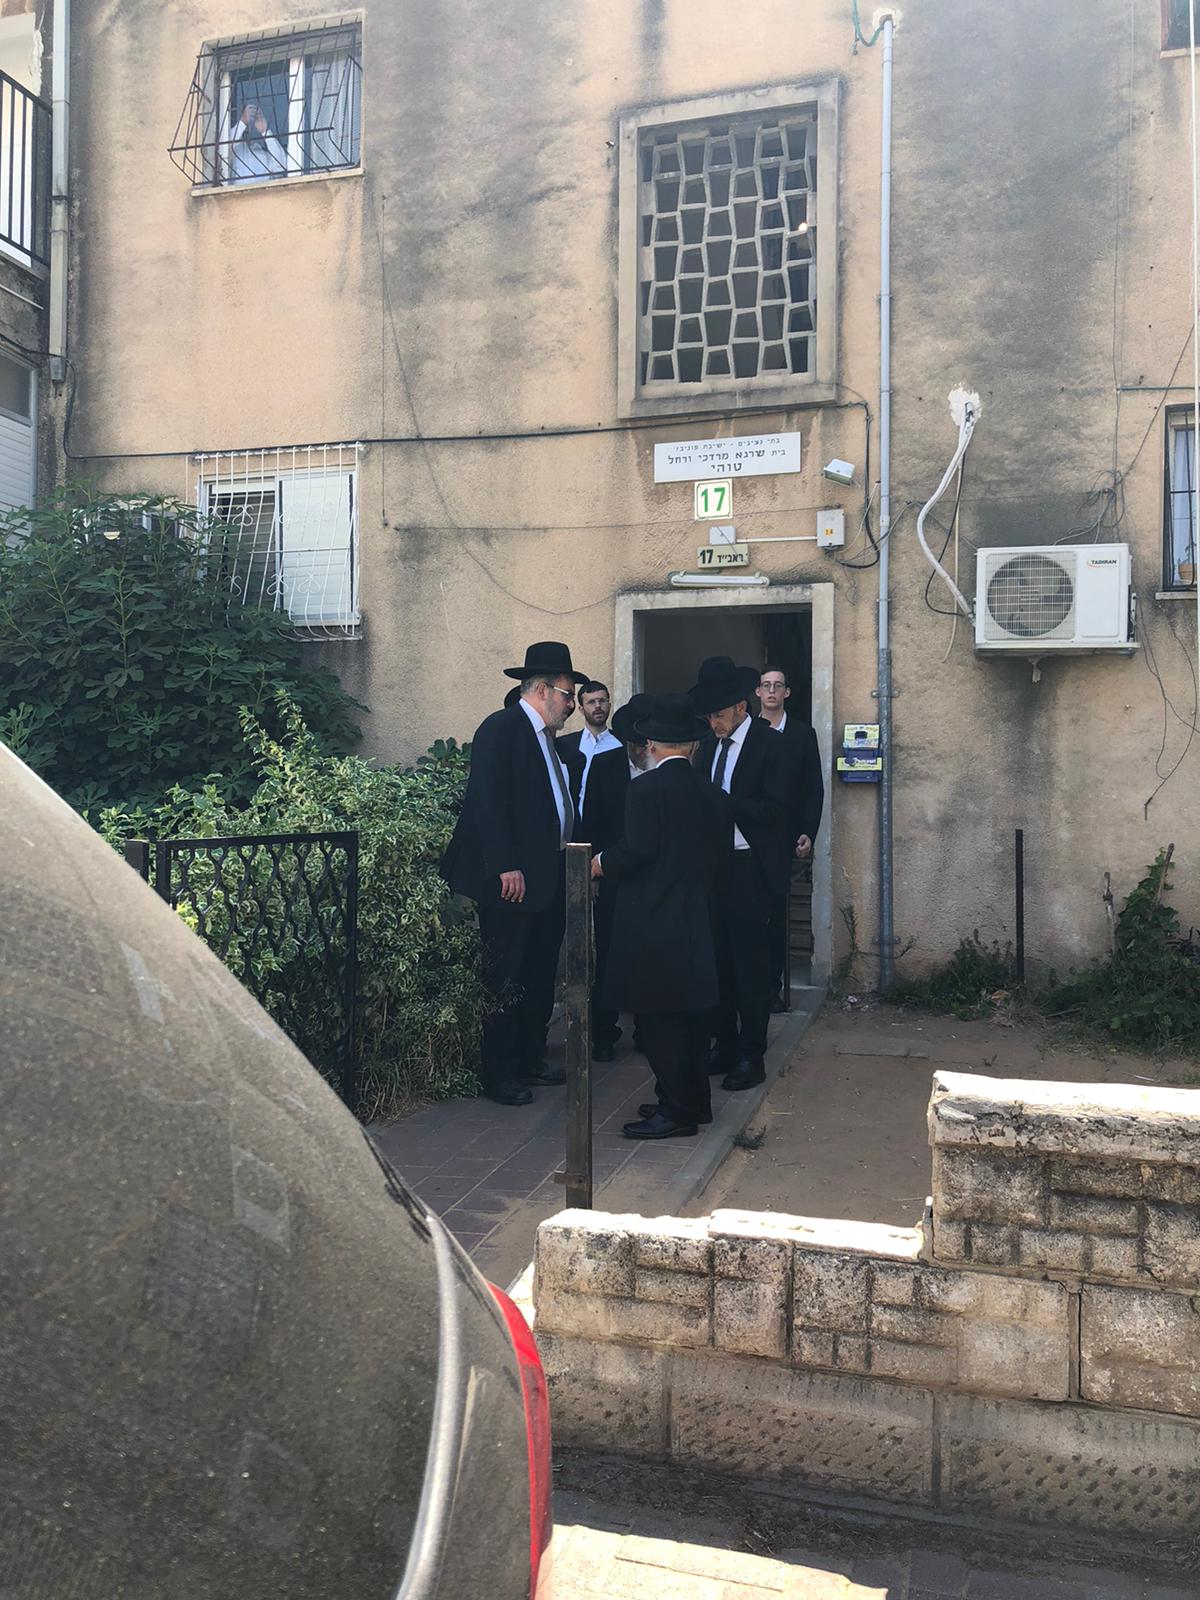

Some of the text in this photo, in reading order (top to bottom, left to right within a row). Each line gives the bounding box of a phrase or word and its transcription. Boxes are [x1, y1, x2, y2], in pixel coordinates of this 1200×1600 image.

[702, 442, 726, 450] ישיבת
[698, 452, 729, 462] מרדכי
[735, 449, 765, 459] שרגא
[667, 455, 692, 465] ורחל
[711, 462, 742, 472] טוהי
[701, 487, 726, 512] 17
[699, 549, 714, 564] 17
